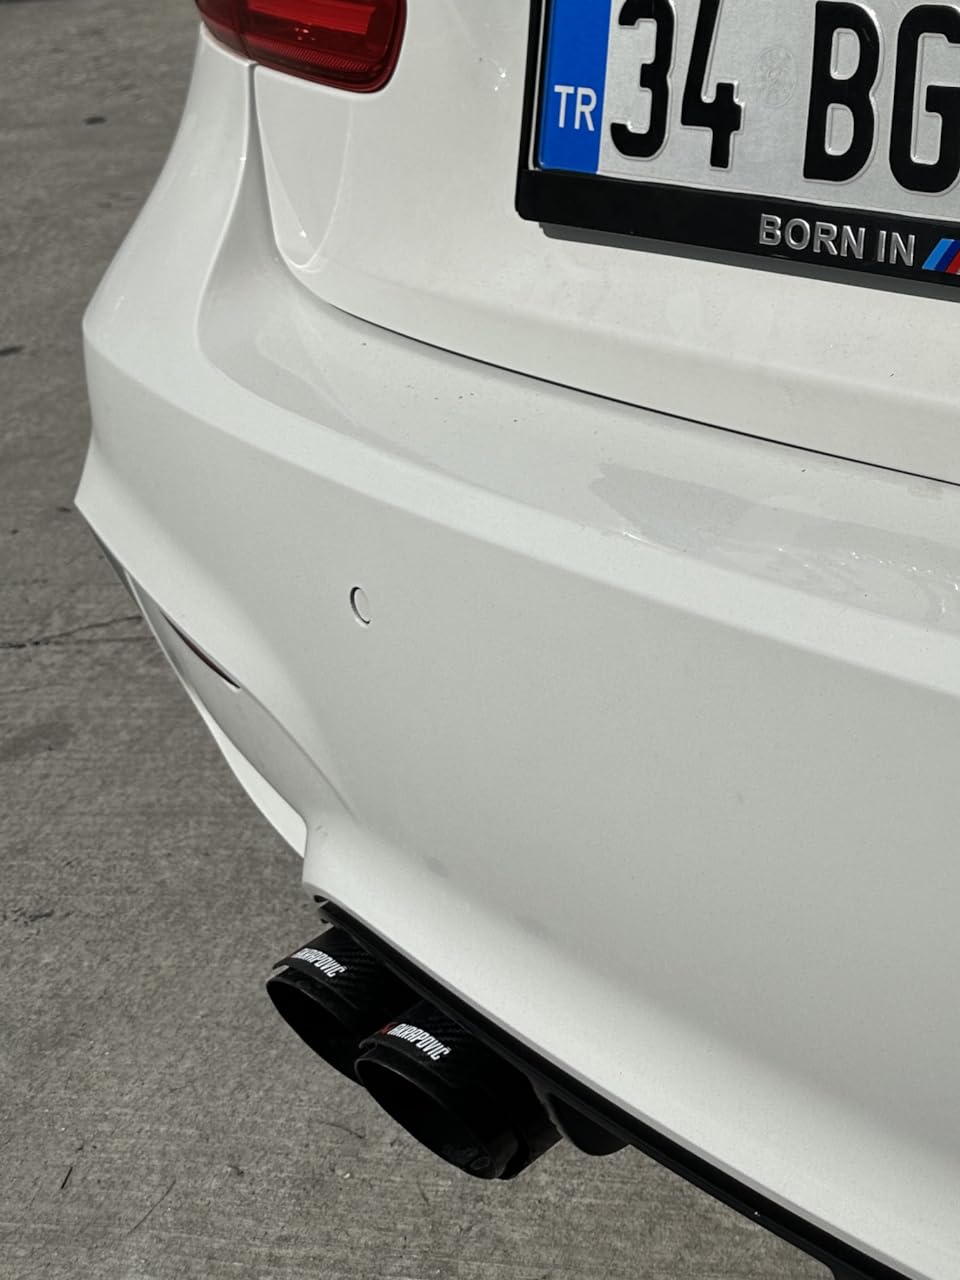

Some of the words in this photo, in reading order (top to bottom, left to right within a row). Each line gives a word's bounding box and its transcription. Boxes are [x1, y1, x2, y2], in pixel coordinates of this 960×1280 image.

[553, 84, 597, 131] TR
[758, 213, 866, 260] BORN
[876, 229, 916, 267] IN
